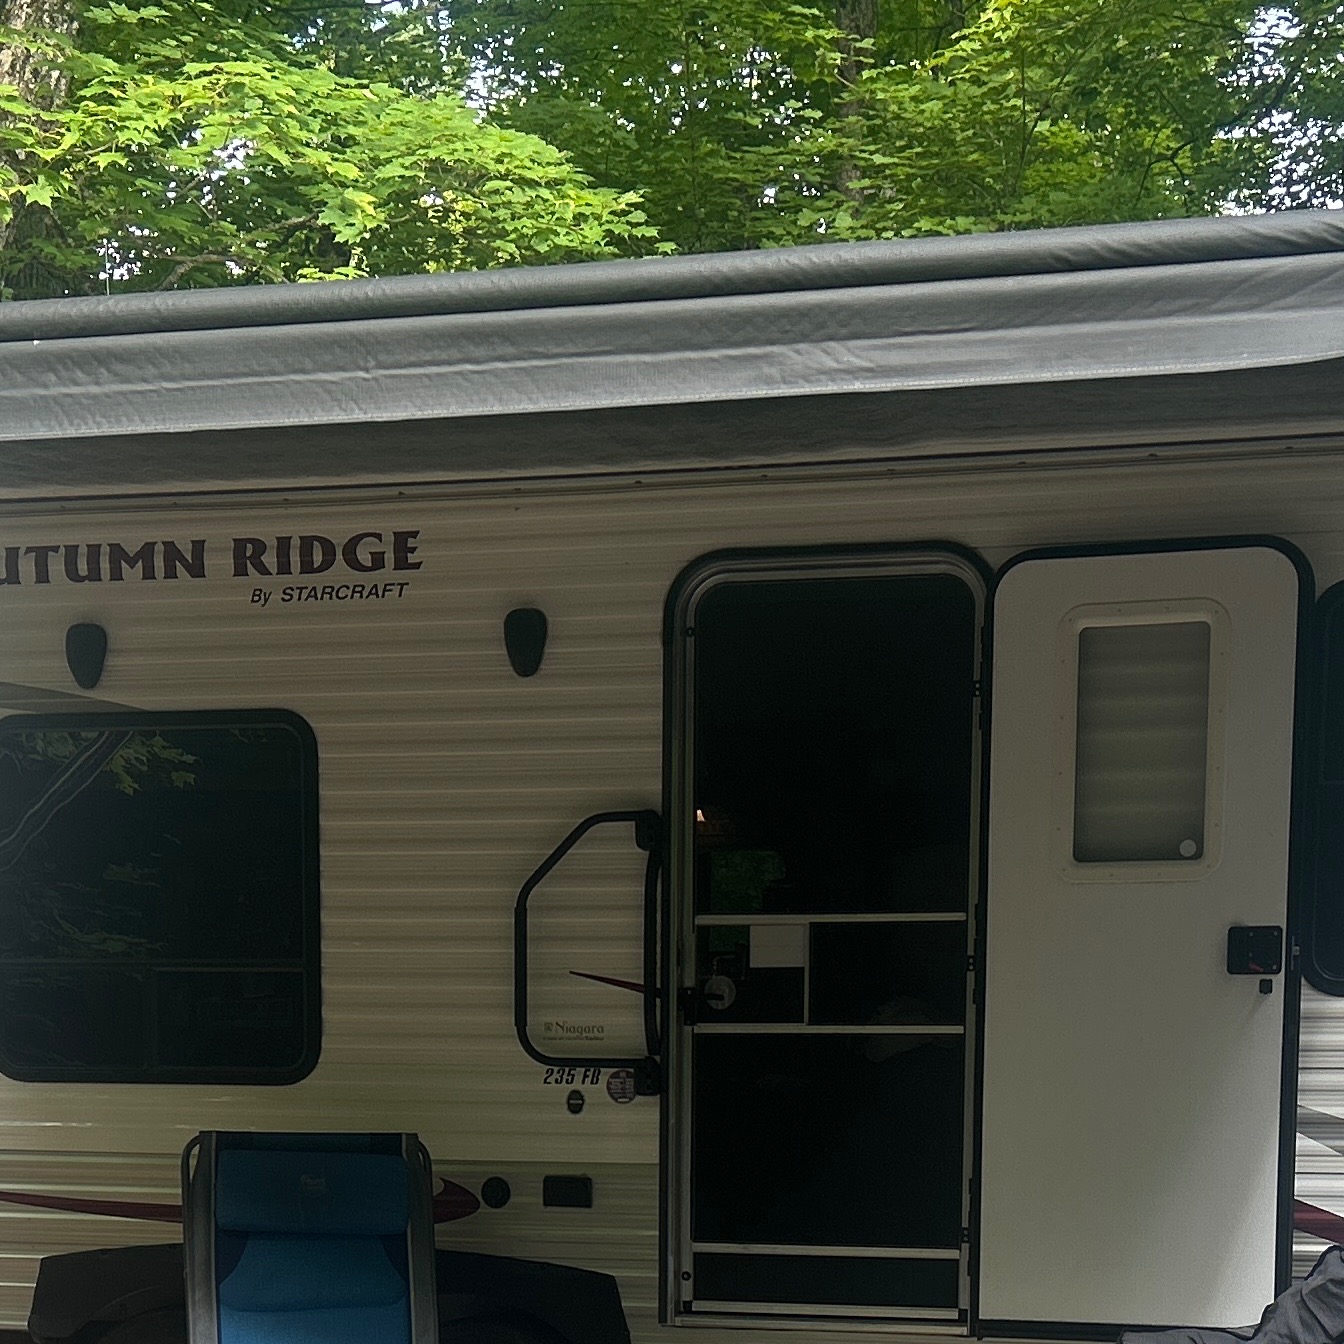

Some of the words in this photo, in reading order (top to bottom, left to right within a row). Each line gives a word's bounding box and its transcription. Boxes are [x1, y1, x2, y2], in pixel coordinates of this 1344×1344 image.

[231, 529, 424, 578] RIDGE
[250, 588, 272, 606] By
[280, 582, 410, 603] STARCRAFT
[555, 1020, 605, 1036] Niagara
[543, 1067, 576, 1085] 235
[581, 1067, 602, 1085] FB
